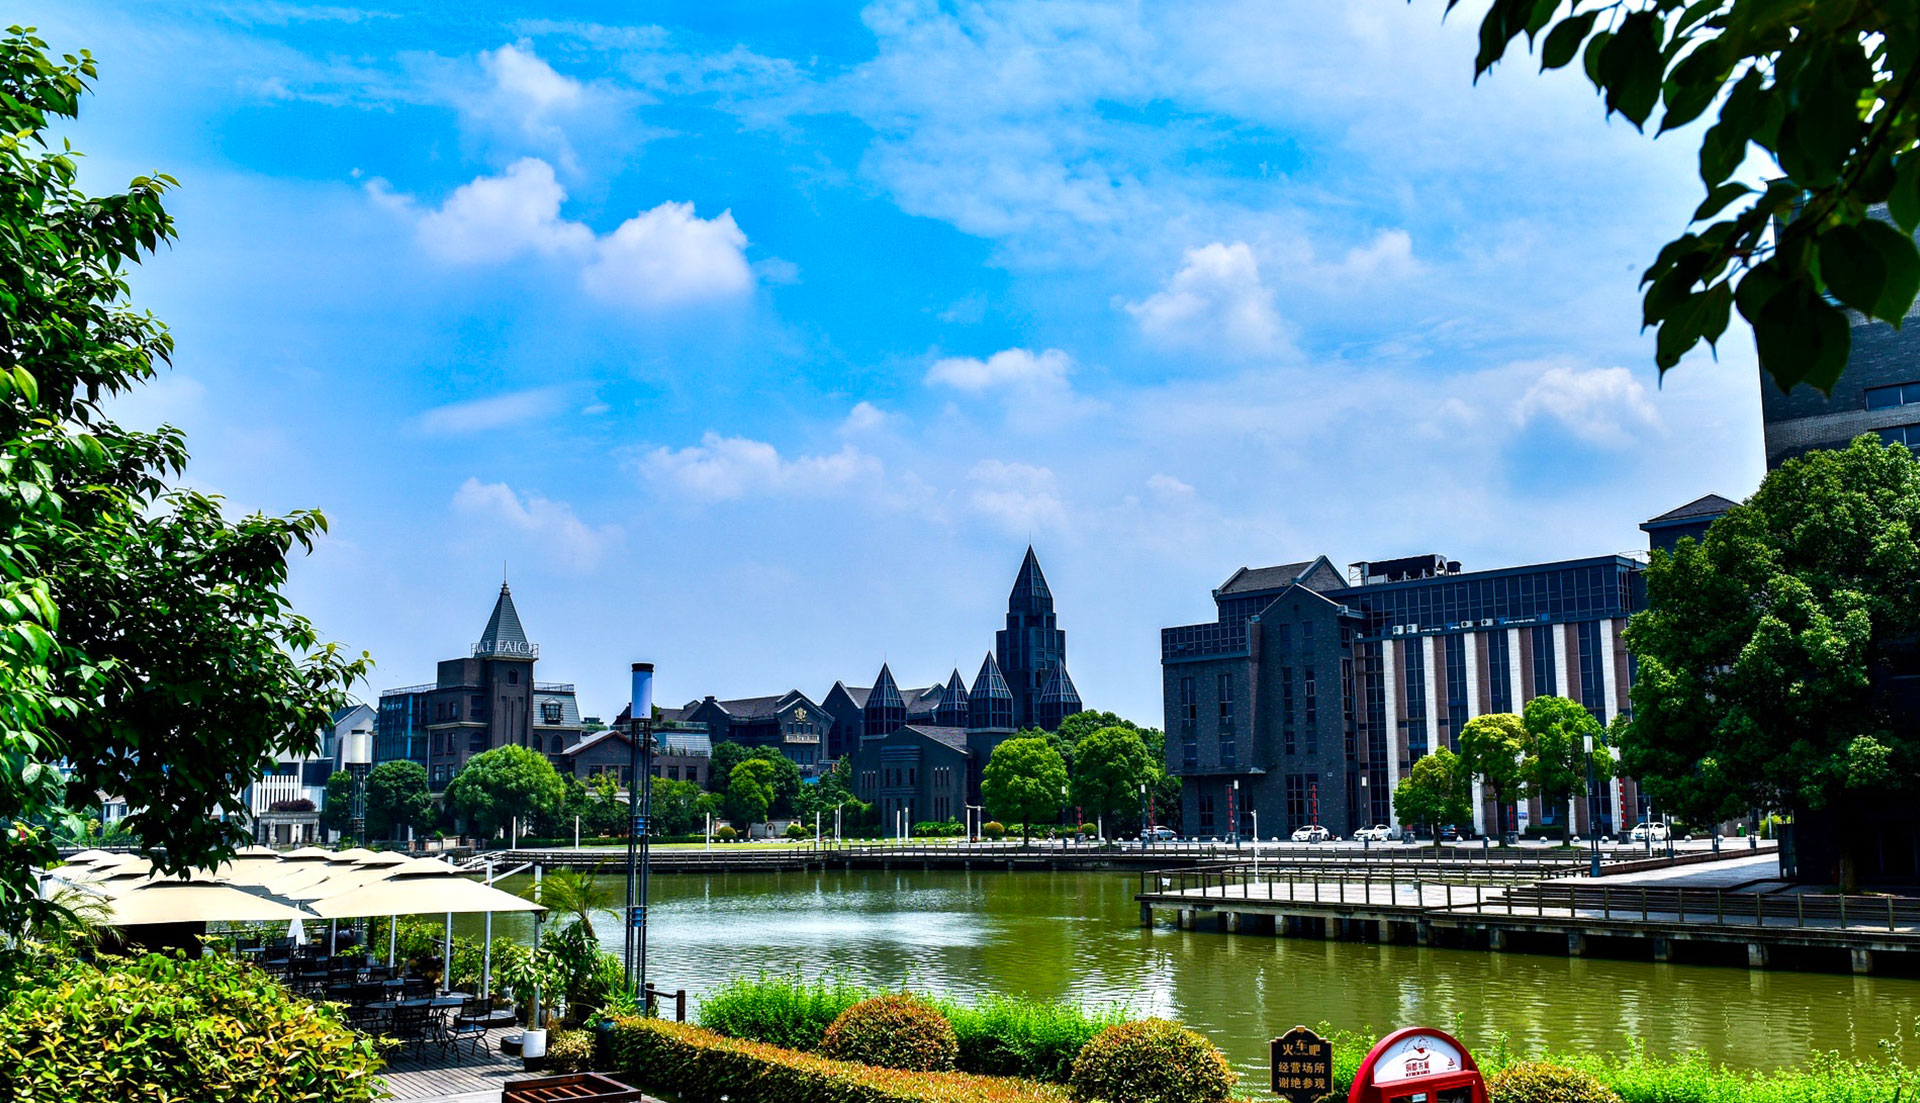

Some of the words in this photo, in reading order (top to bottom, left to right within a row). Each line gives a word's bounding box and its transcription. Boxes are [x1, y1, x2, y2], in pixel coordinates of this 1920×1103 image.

[1282, 1039, 1321, 1056] 火车吧
[1278, 1062, 1325, 1073] 经营场所
[1278, 1077, 1326, 1089] 谢绝参观
